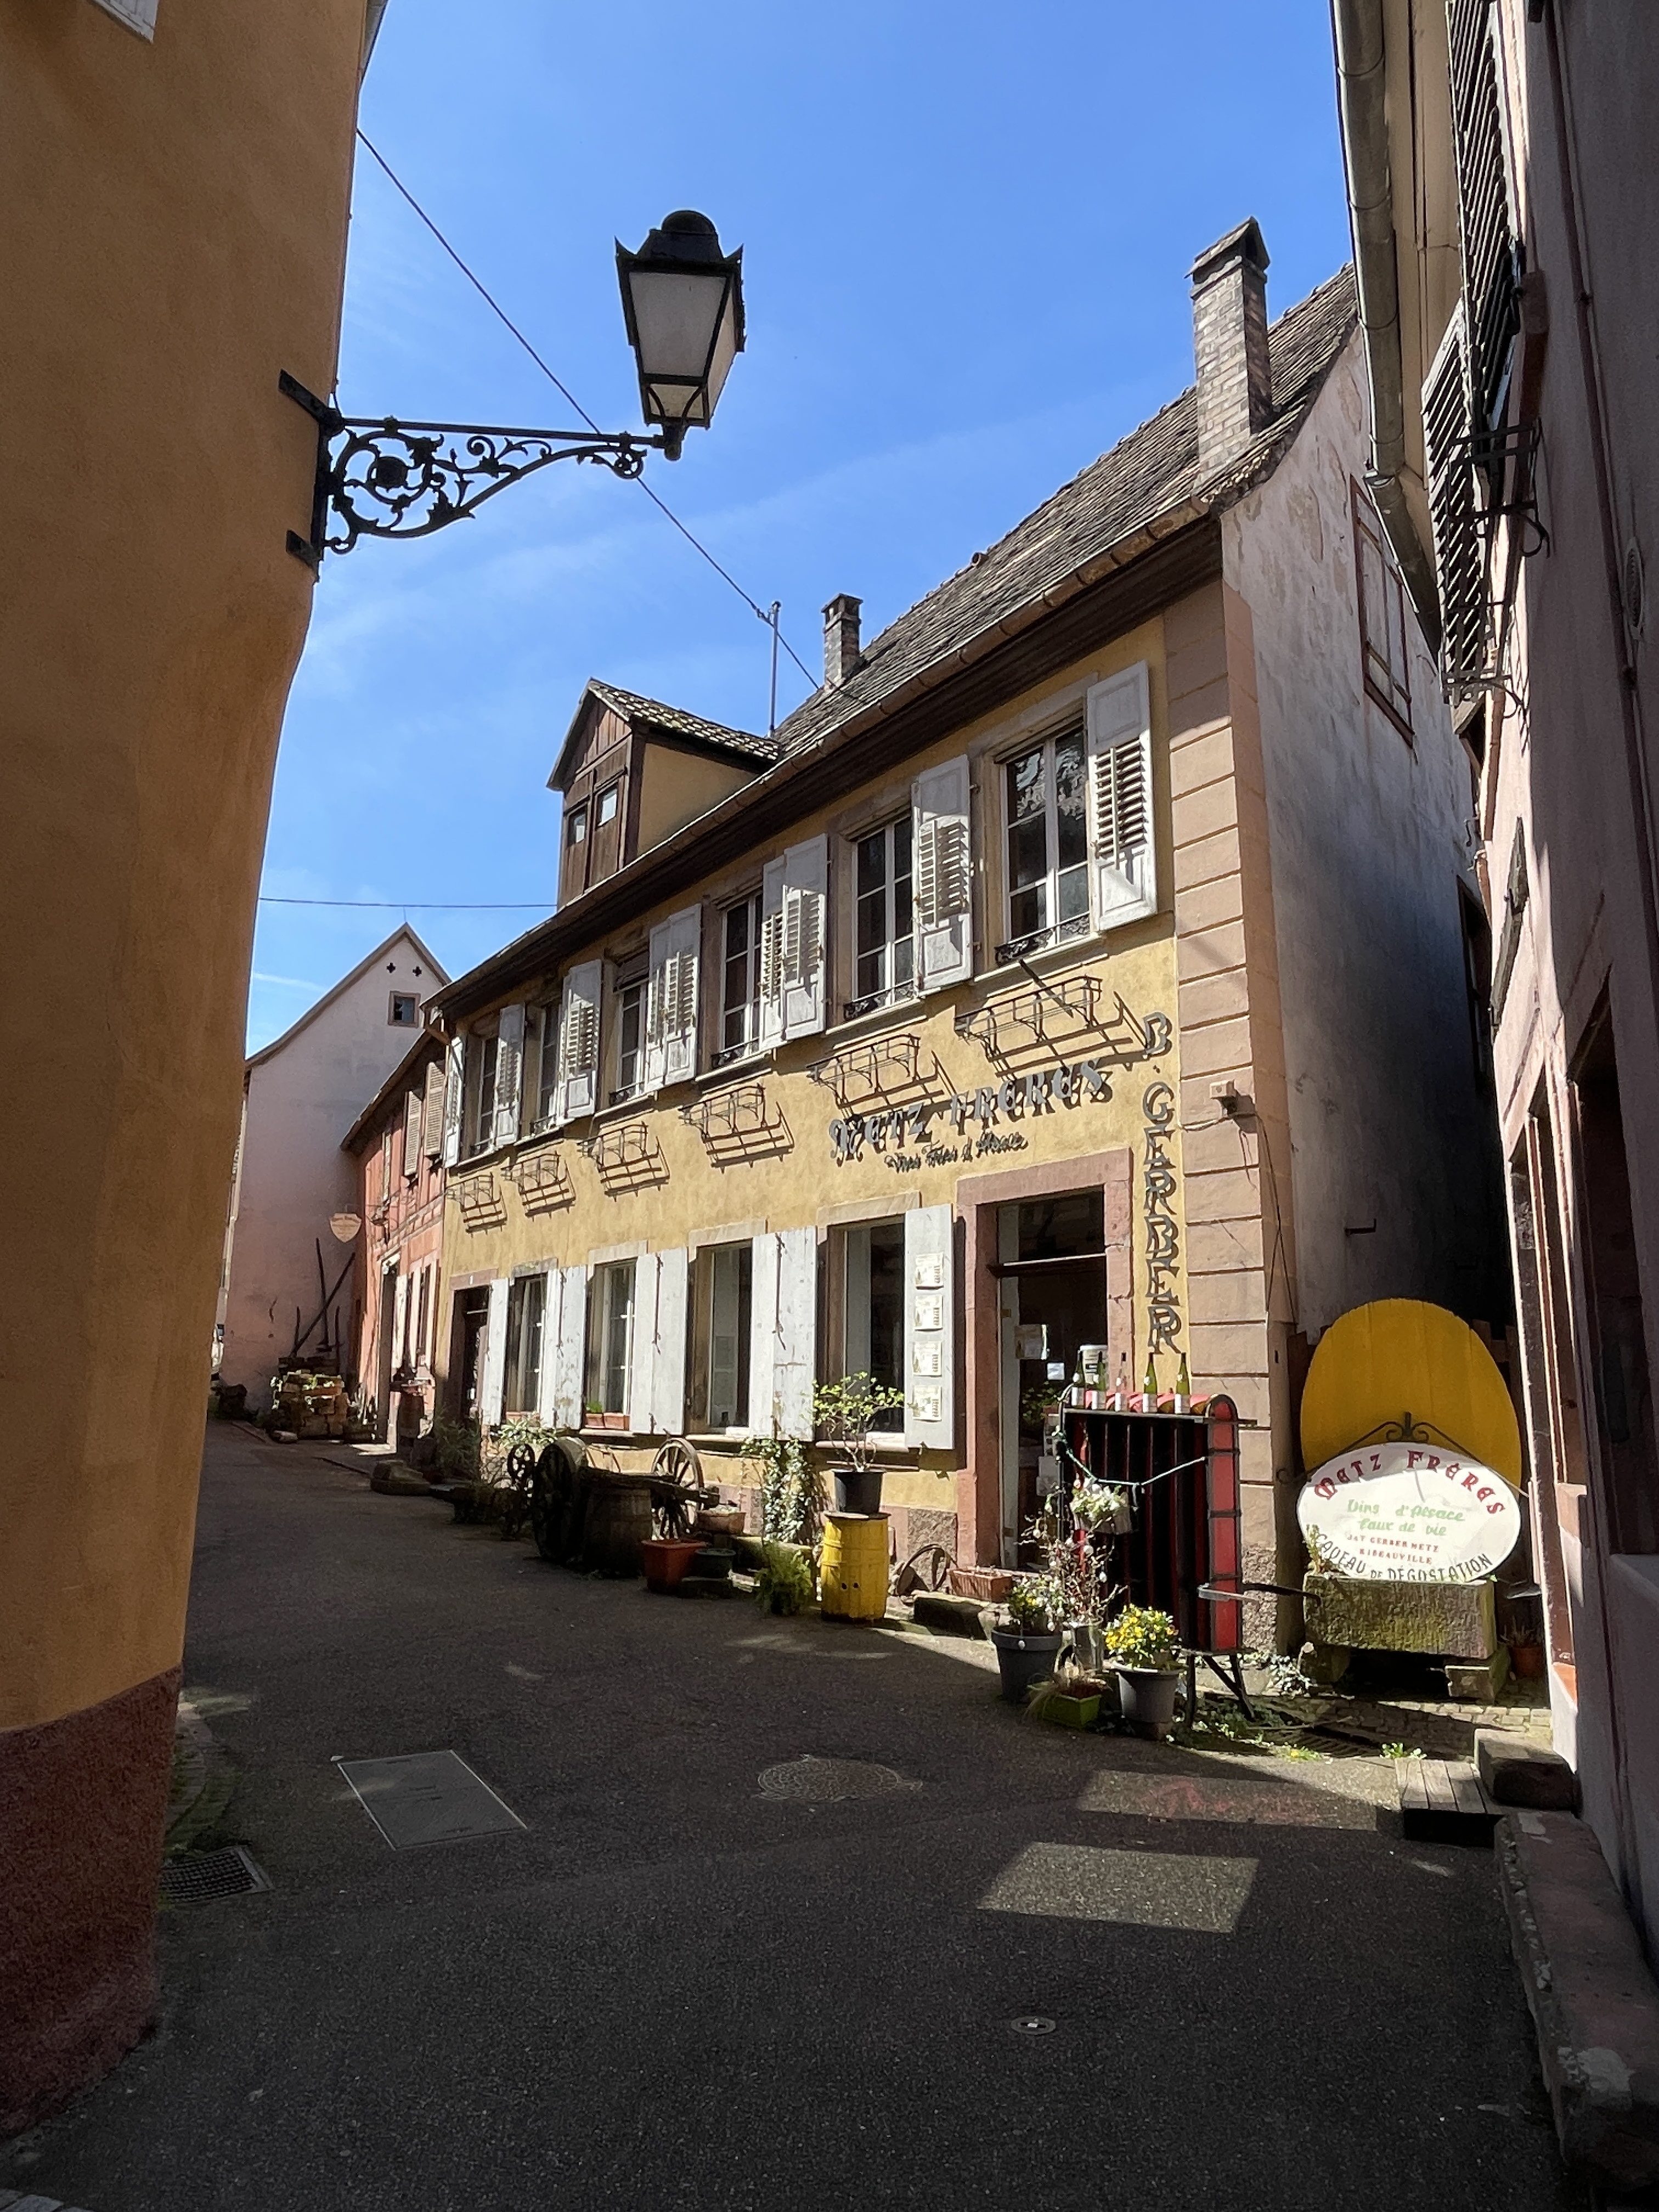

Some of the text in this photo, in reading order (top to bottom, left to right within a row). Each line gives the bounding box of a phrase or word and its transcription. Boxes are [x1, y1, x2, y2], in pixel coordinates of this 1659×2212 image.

[1143, 1081, 1181, 1355] GERBER
[1314, 1453, 1383, 1500] METZ
[1347, 1499, 1380, 1514] Vins
[1398, 1521, 1415, 1532] de
[1425, 1523, 1447, 1536] vie
[1410, 1543, 1440, 1553] METZ
